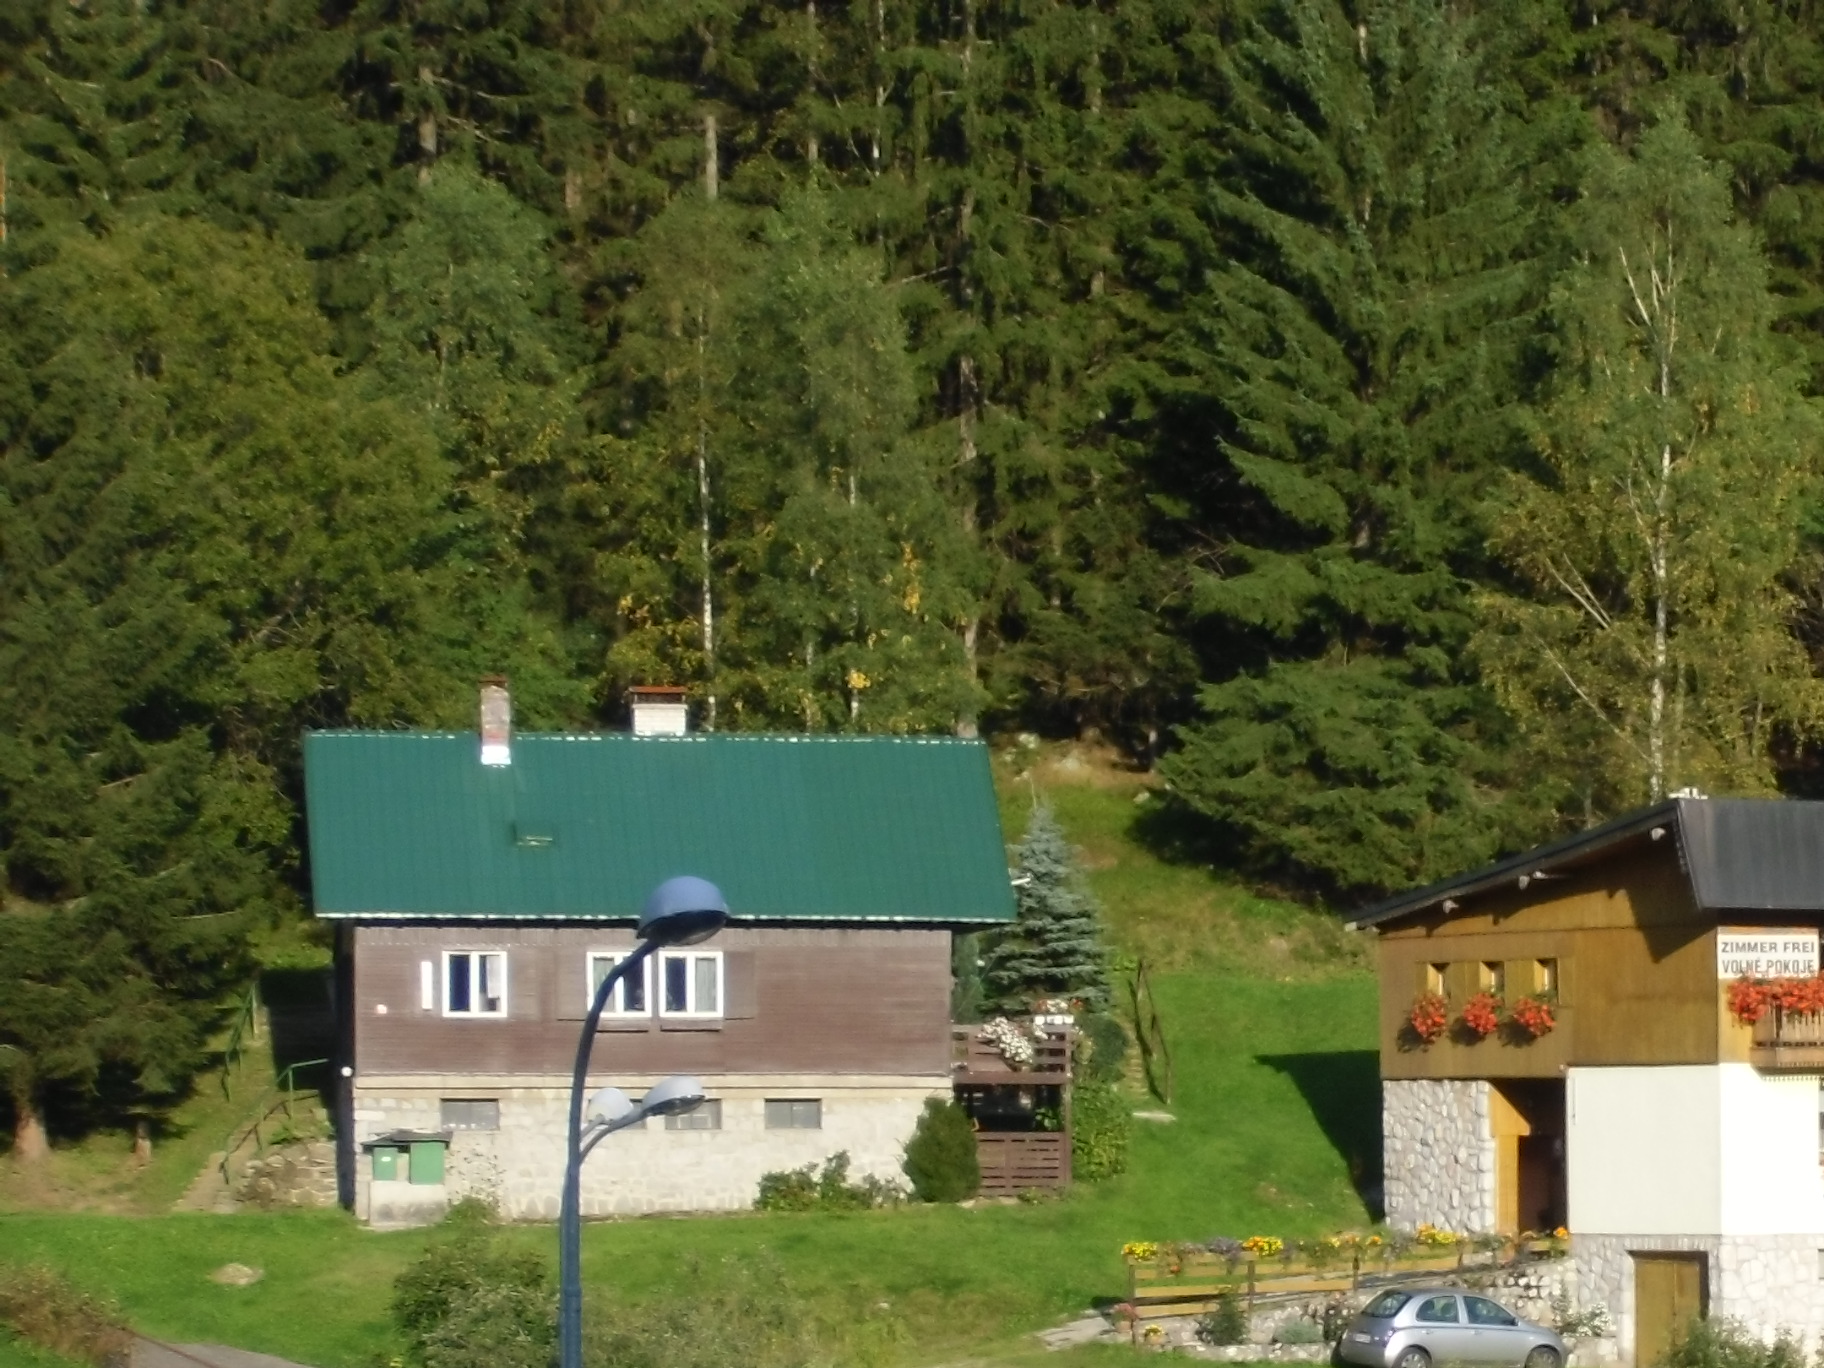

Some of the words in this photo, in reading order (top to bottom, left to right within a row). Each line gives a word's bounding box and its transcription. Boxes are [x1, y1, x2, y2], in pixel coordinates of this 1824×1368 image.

[1721, 942, 1777, 953] ZIMMER
[1783, 942, 1815, 953] FREI
[1766, 959, 1815, 974] POKOJE
